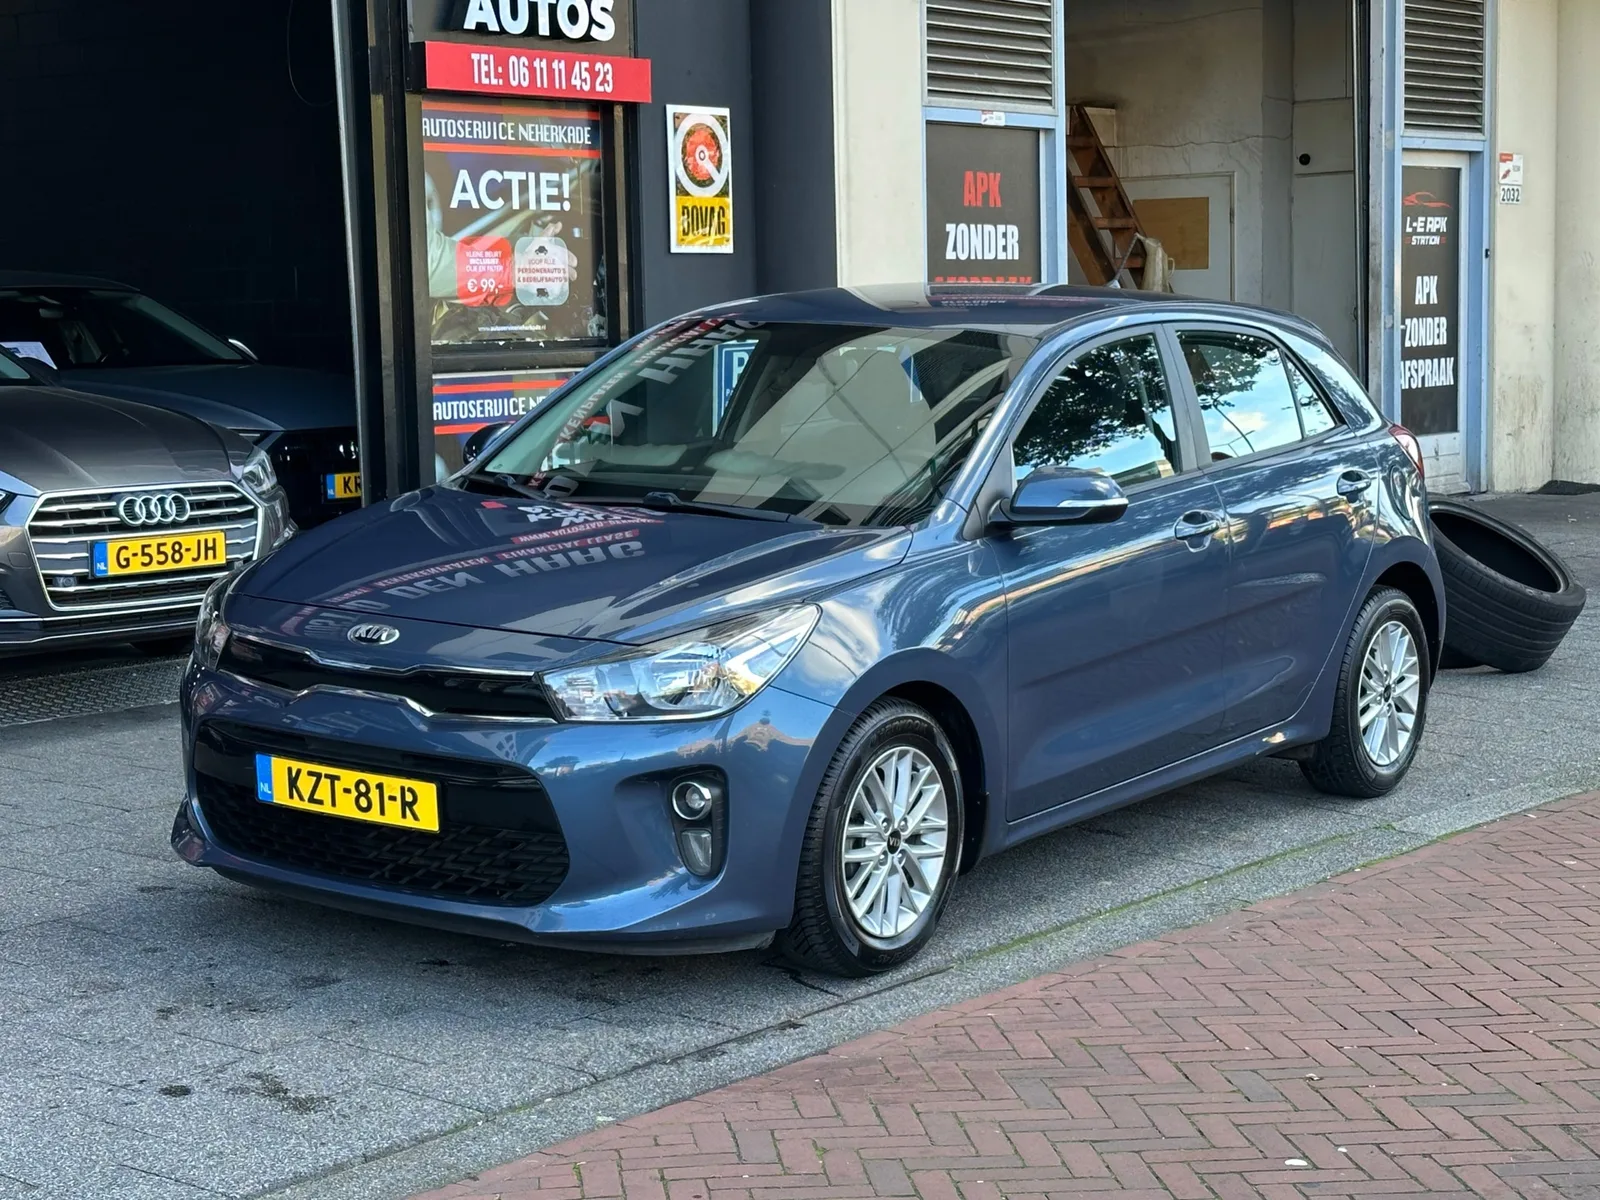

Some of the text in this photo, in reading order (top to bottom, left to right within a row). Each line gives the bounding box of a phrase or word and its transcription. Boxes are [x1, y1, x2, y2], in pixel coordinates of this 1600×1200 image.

[463, 0, 616, 42] AUTOS
[471, 53, 614, 93] TEL: 06 11 11 45 23
[422, 117, 592, 145] AUTOSERVICE NEHERKADE
[450, 169, 572, 212] ACTIE!
[963, 170, 1002, 208] APK
[1501, 187, 1520, 203] 2032
[681, 205, 726, 237] BOVAG
[945, 223, 1020, 261] ZONDER
[1411, 235, 1441, 246] STATION
[1415, 275, 1438, 305] APK
[1404, 316, 1448, 348] ZONDER
[433, 397, 527, 421] AUTOSERVICE
[96, 538, 217, 571] NL G-558-JH
[354, 624, 391, 642] KIA
[260, 766, 421, 822] NL KZT-81-R
